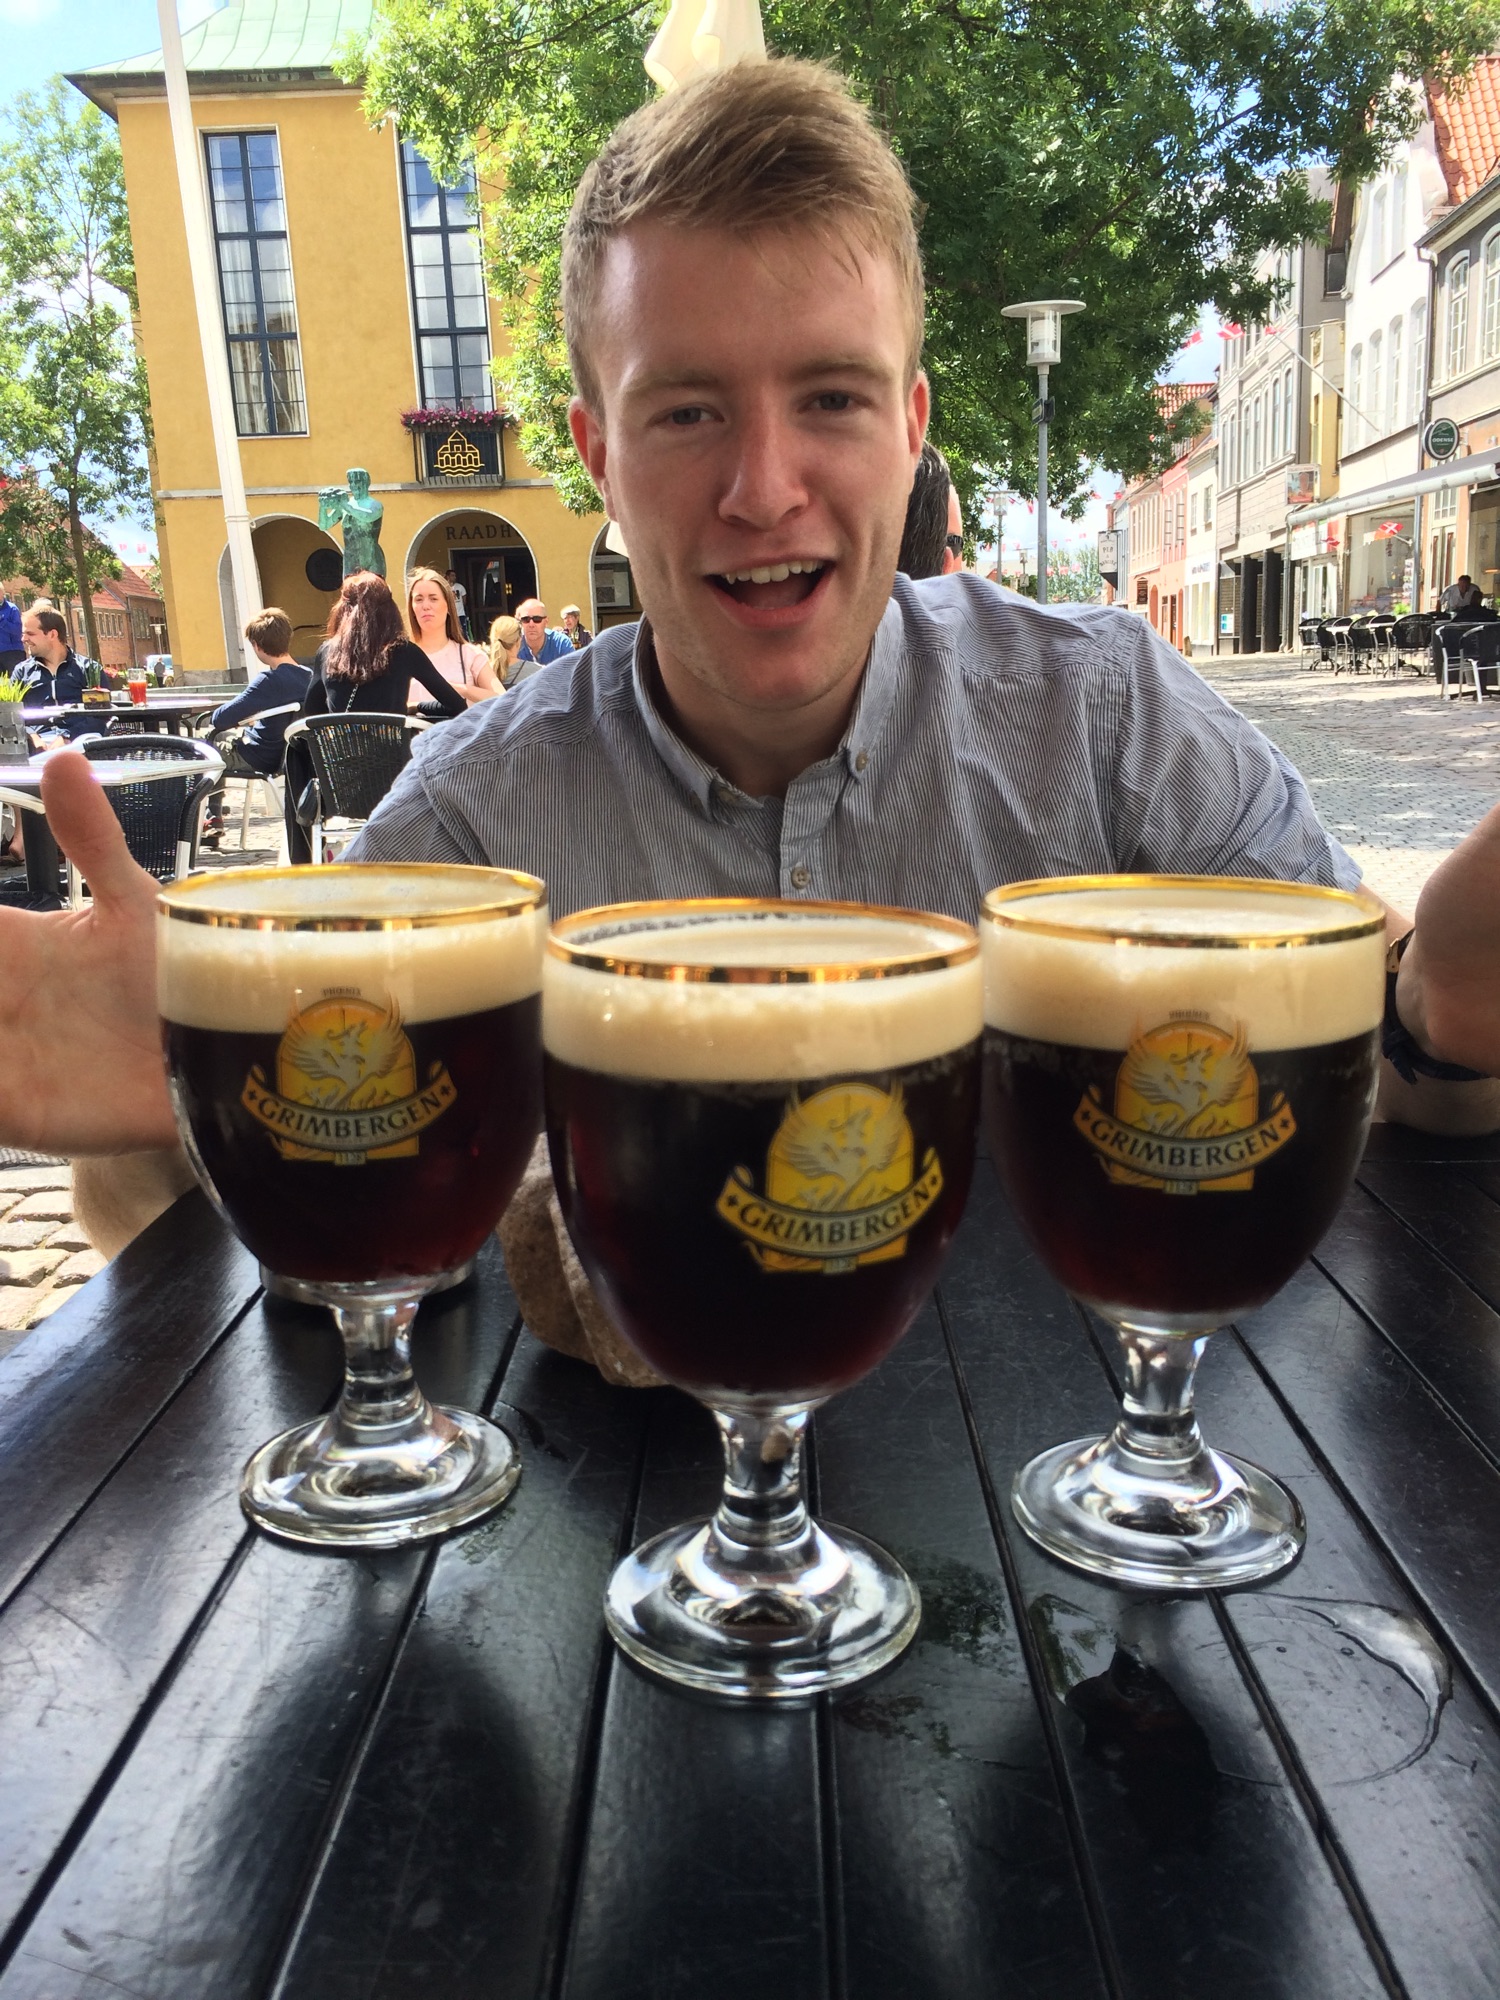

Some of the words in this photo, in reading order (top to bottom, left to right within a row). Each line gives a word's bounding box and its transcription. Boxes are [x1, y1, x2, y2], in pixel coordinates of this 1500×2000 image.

[446, 524, 521, 540] RAADH
[257, 1092, 442, 1138] GRIMBERGEN
[1090, 1119, 1281, 1168] GRIMBERGEN
[739, 1182, 930, 1243] GRIMBERGEN
